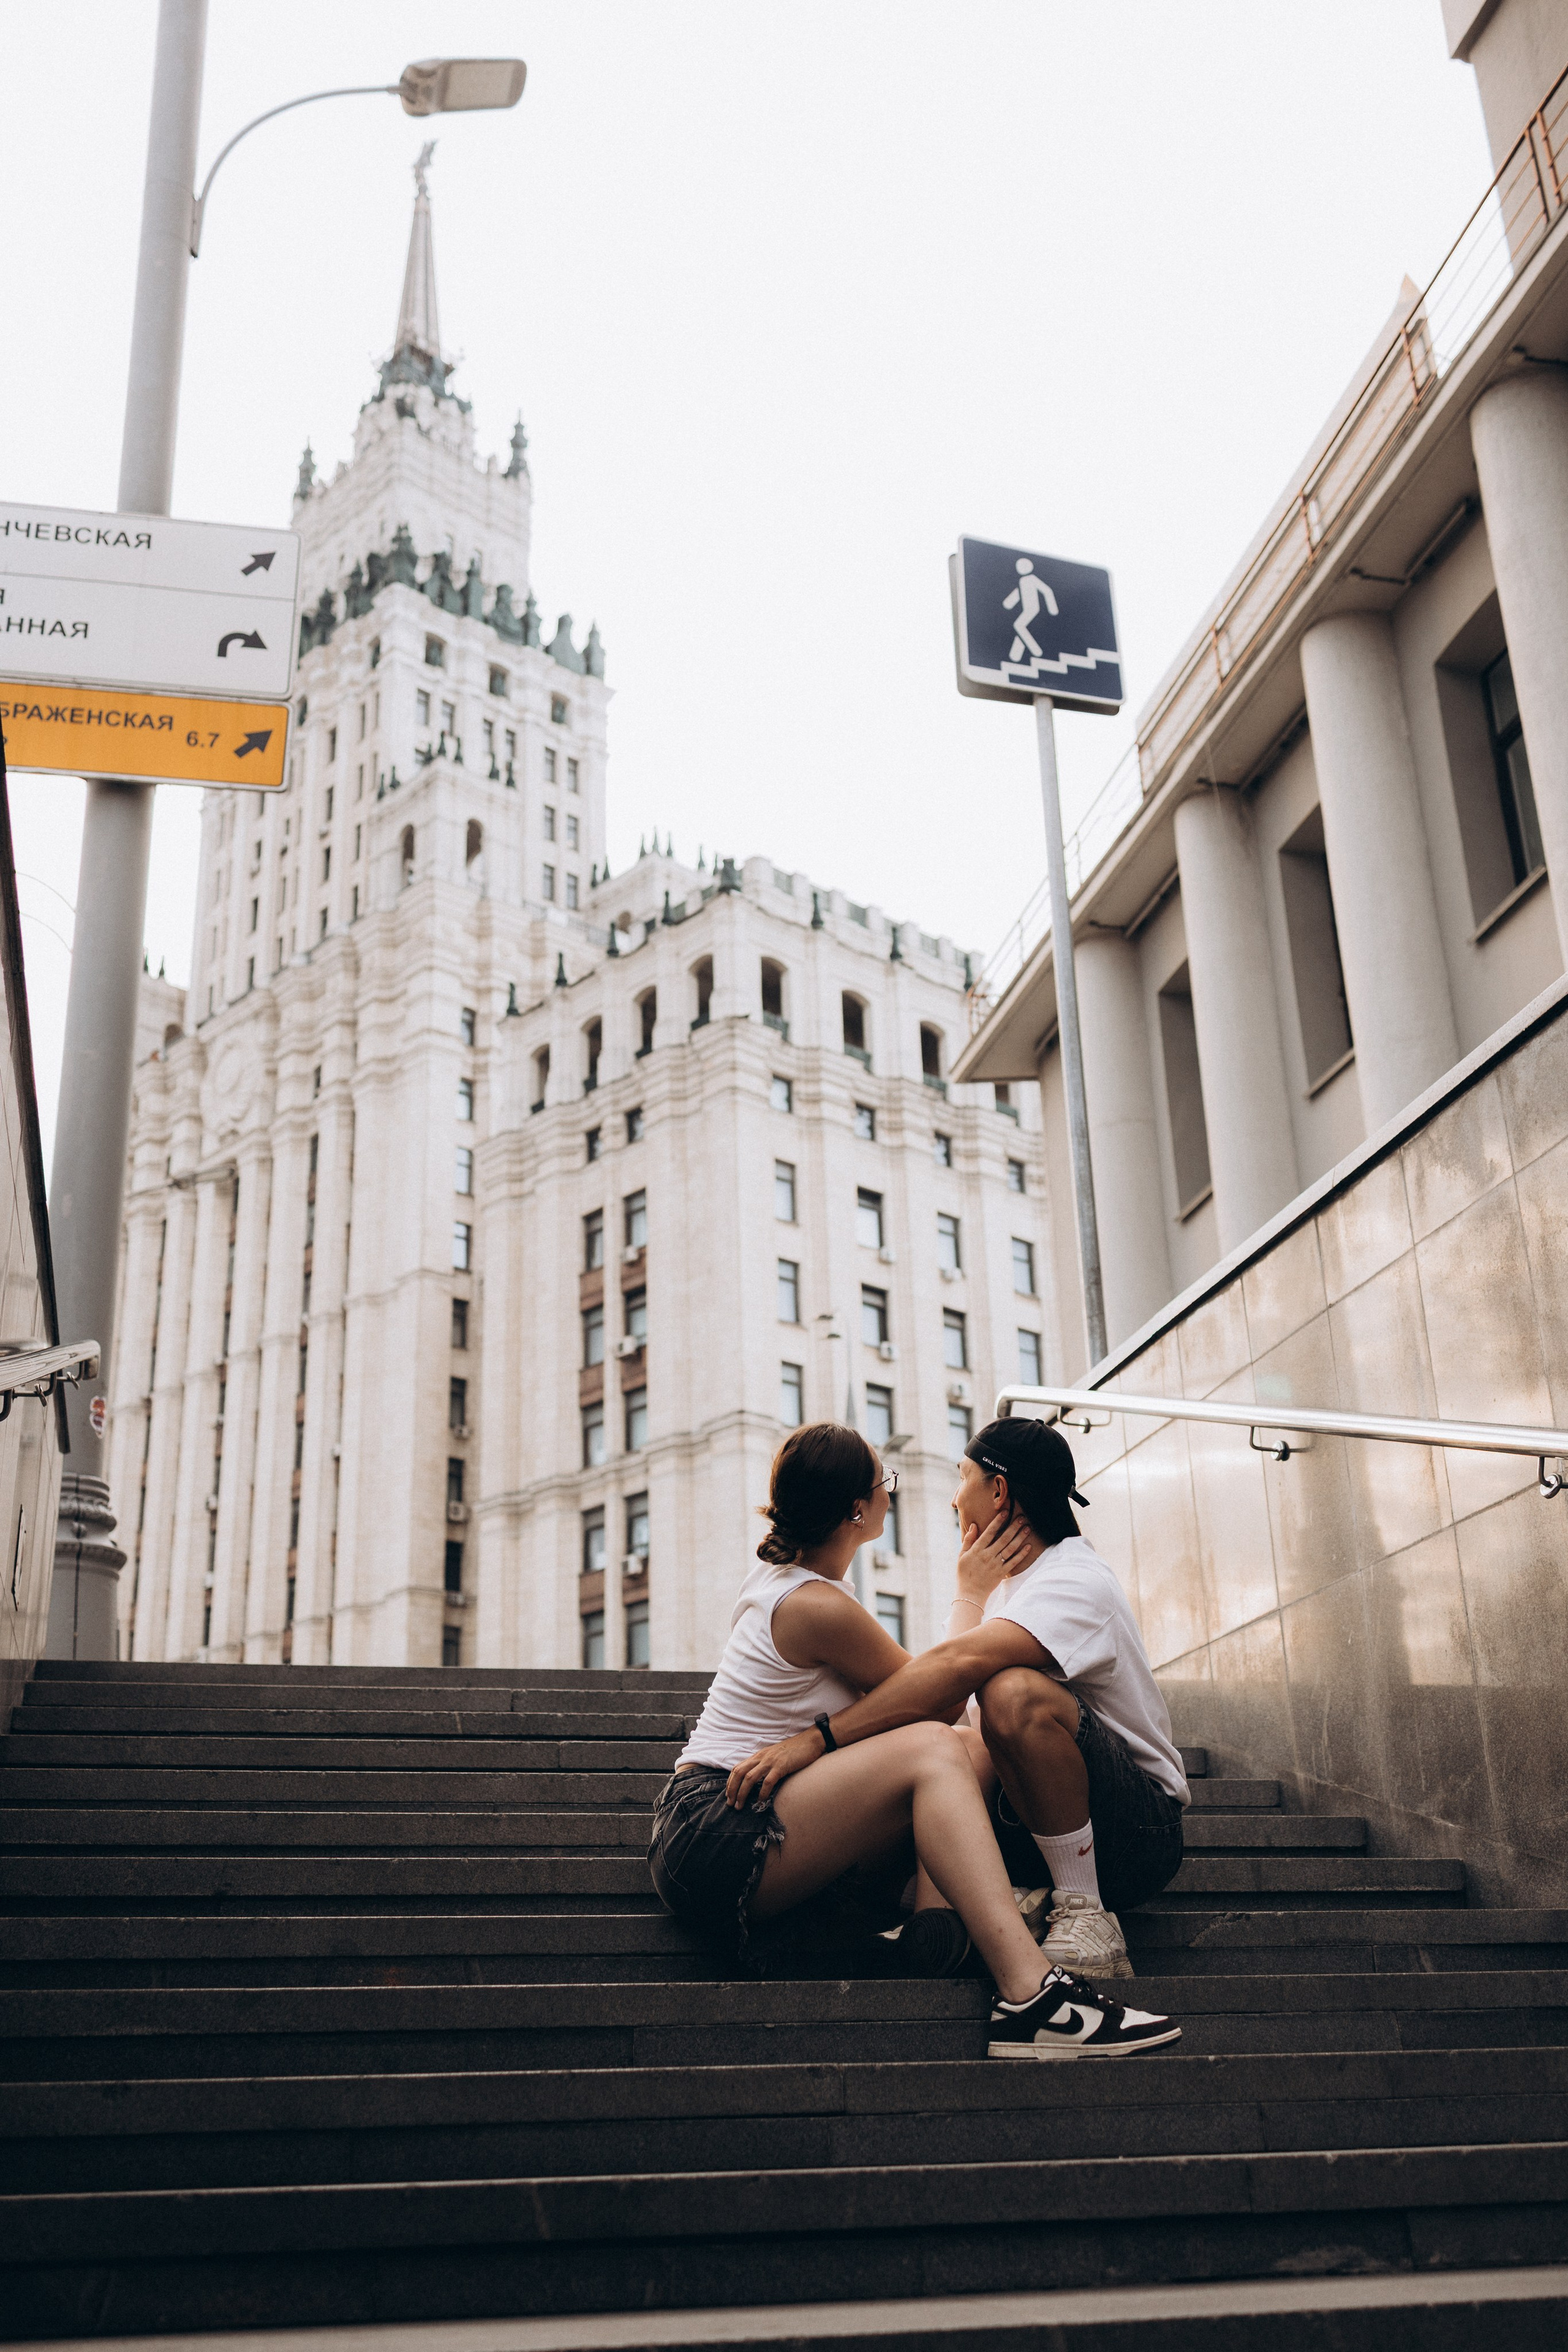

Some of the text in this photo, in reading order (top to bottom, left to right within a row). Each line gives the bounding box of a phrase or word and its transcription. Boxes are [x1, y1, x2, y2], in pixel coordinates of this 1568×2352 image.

[0, 616, 89, 638] ННАЯ
[186, 731, 219, 748] 6.7
[982, 1457, 994, 1466] CHILL
